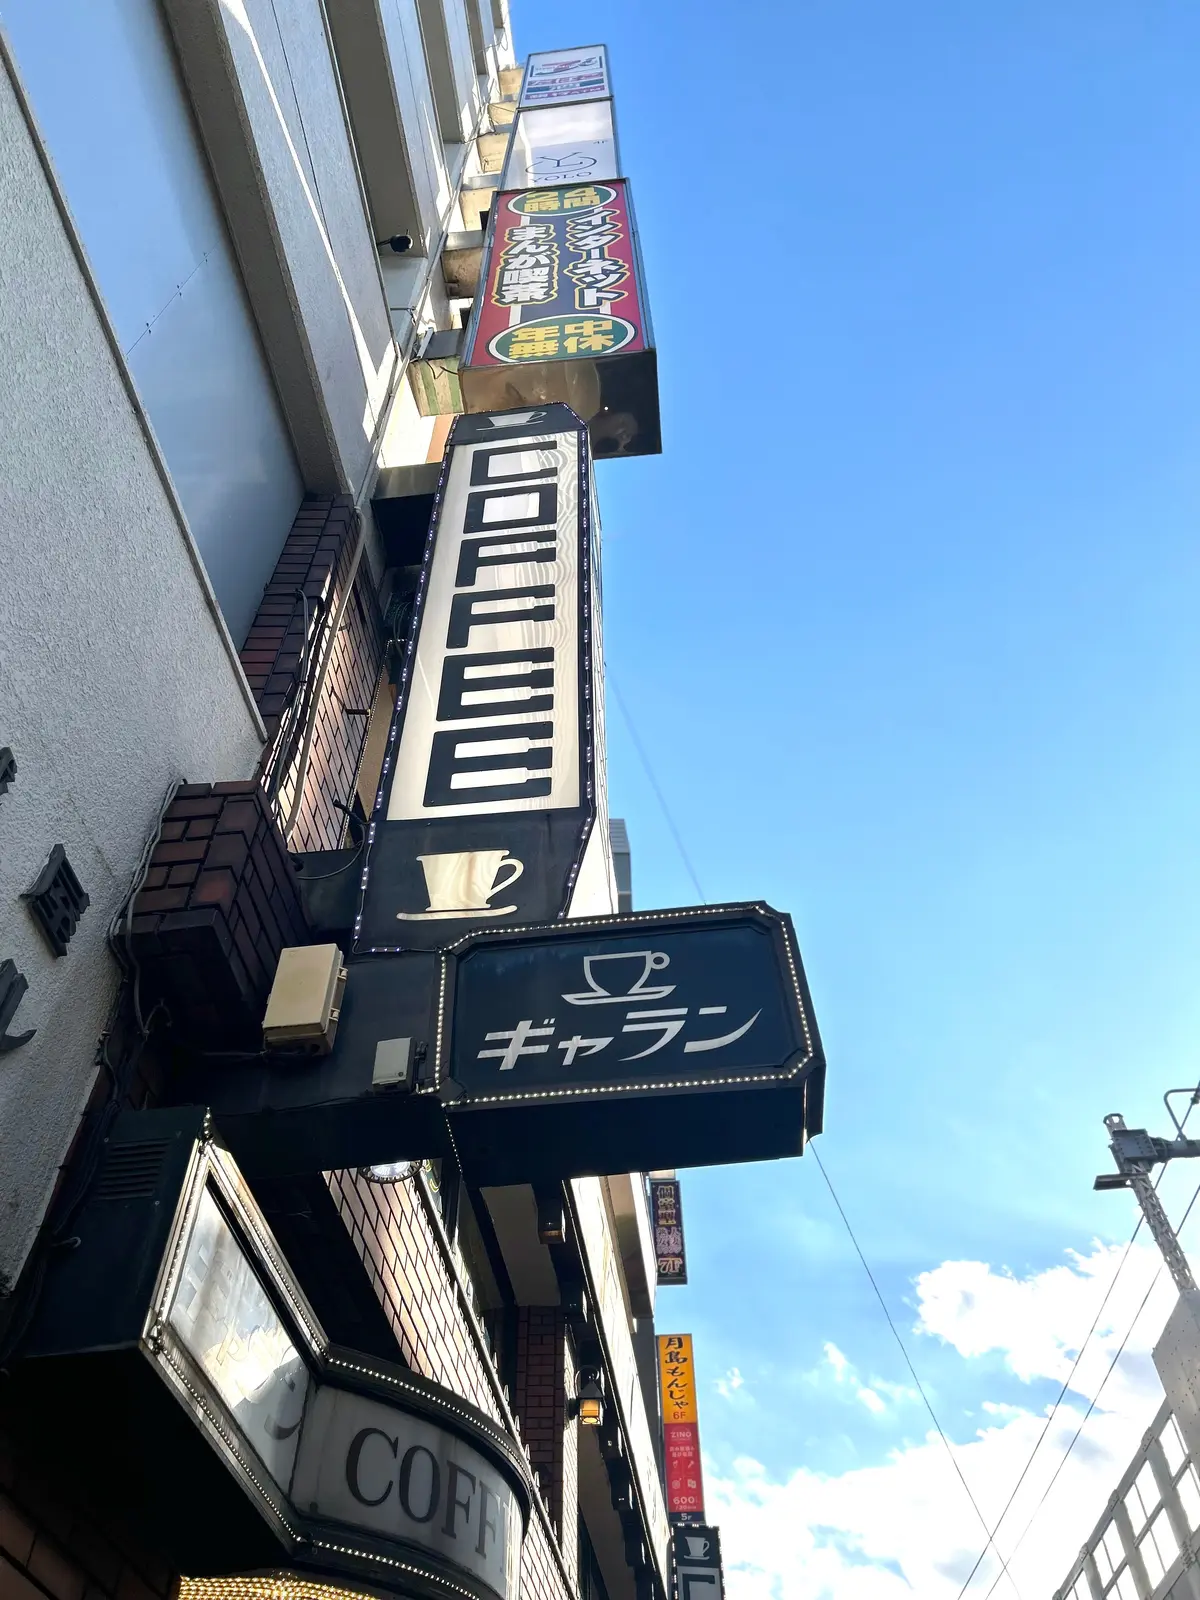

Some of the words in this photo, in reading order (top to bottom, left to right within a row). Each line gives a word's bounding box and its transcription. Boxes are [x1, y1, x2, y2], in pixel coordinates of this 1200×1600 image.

[530, 171, 592, 183] YOLO
[501, 226, 551, 303] まんが喫茶
[573, 210, 623, 306] インターネット
[477, 1006, 763, 1071] ギャラン
[665, 1337, 689, 1409] 月島もんじゃ
[673, 1411, 686, 1420] 6F
